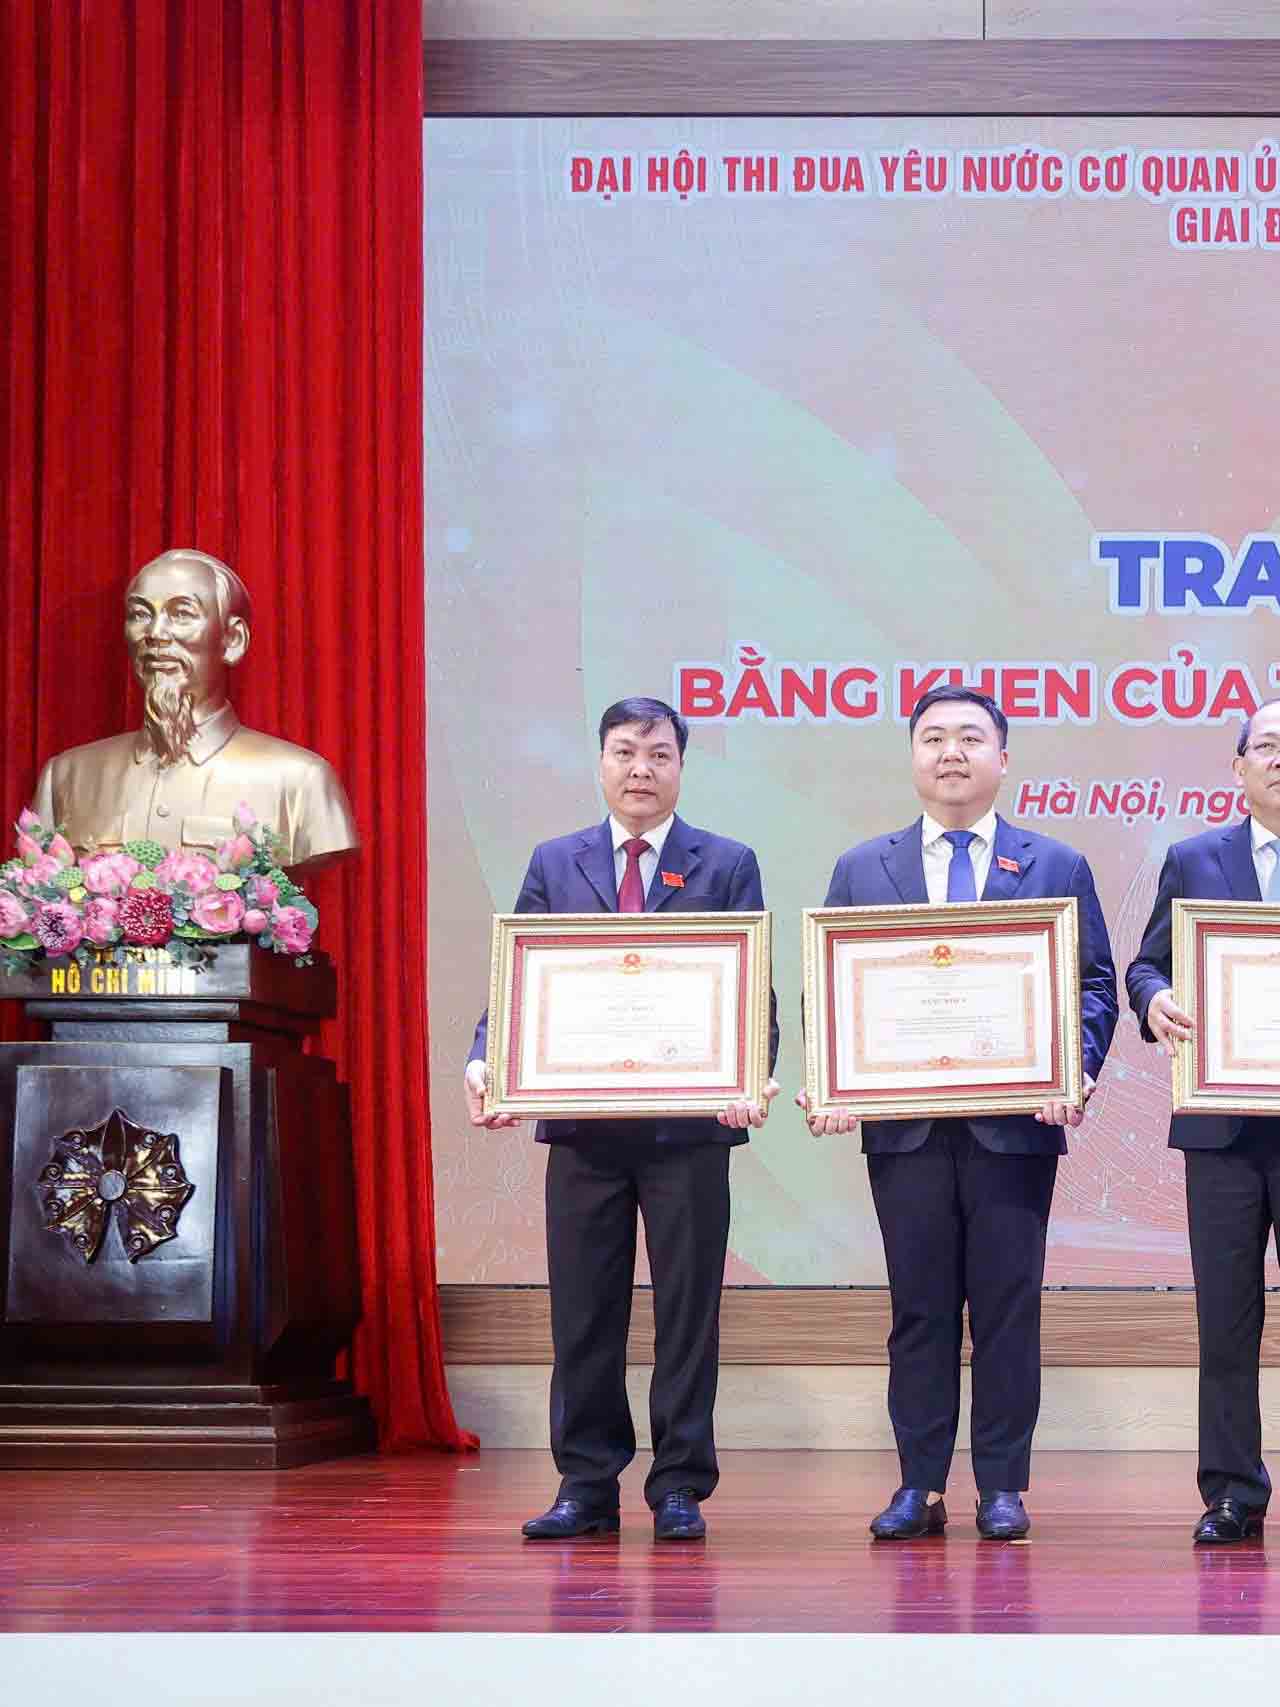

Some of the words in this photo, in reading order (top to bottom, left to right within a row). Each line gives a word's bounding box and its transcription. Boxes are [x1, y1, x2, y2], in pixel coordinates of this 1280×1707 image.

[570, 156, 632, 201] ĐẠI
[647, 149, 707, 200] HỘI
[722, 156, 779, 193] THI
[792, 156, 865, 193] ĐUA
[880, 149, 947, 193] YÊU
[962, 148, 1063, 193] NƯỚC
[1079, 153, 1128, 193] CƠ
[1142, 156, 1240, 198] QUAN
[1176, 207, 1250, 243] GIAI
[679, 646, 878, 718] BẰNG
[1111, 650, 1258, 719] CỦA
[1018, 783, 1076, 815] Hà
[1089, 783, 1166, 822] Nội,
